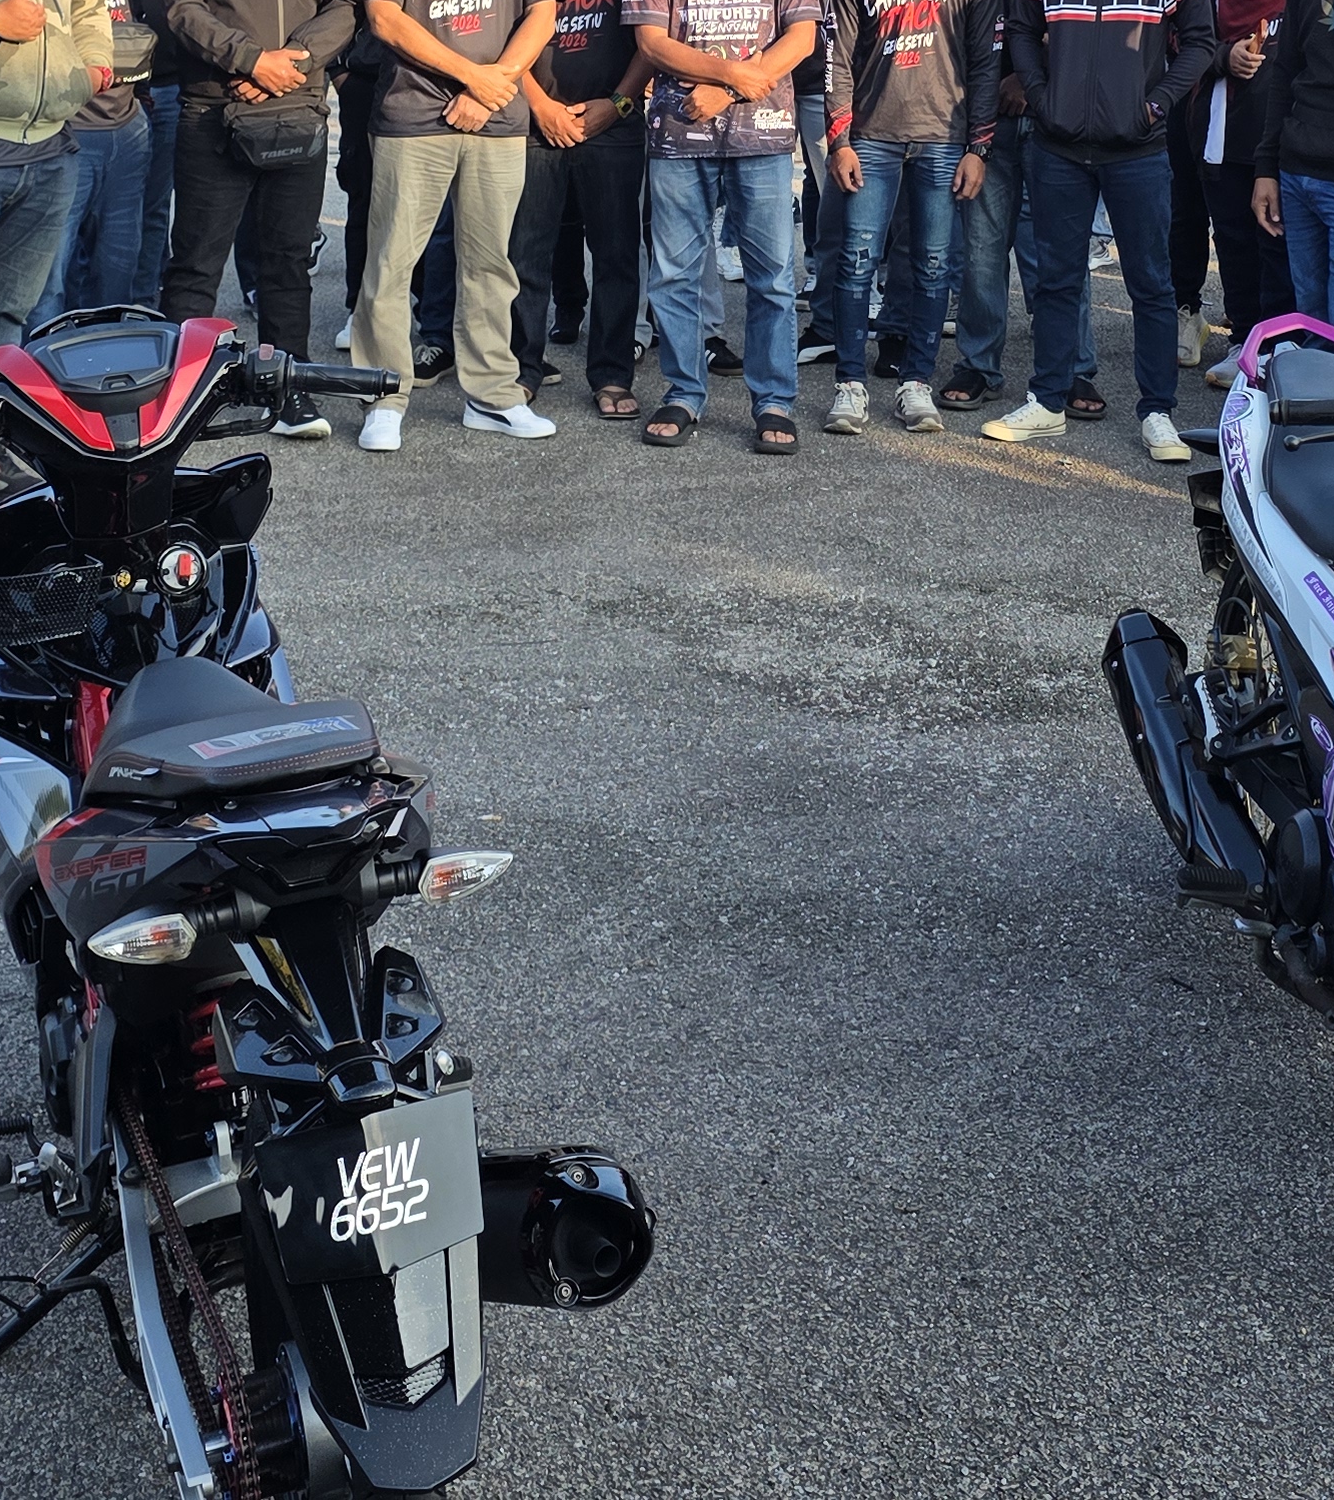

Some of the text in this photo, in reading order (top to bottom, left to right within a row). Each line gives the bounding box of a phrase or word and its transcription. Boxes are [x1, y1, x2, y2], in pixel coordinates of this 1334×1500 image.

[451, 13, 481, 32] 2026
[570, 12, 604, 32] SETIU
[558, 32, 589, 48] 2026
[895, 51, 921, 66] 2026
[260, 145, 304, 160] TAICHI
[1306, 576, 1327, 596] Fuel
[53, 845, 148, 883] EXCITER
[337, 1137, 420, 1197] VEW
[330, 1178, 430, 1242] 6652
